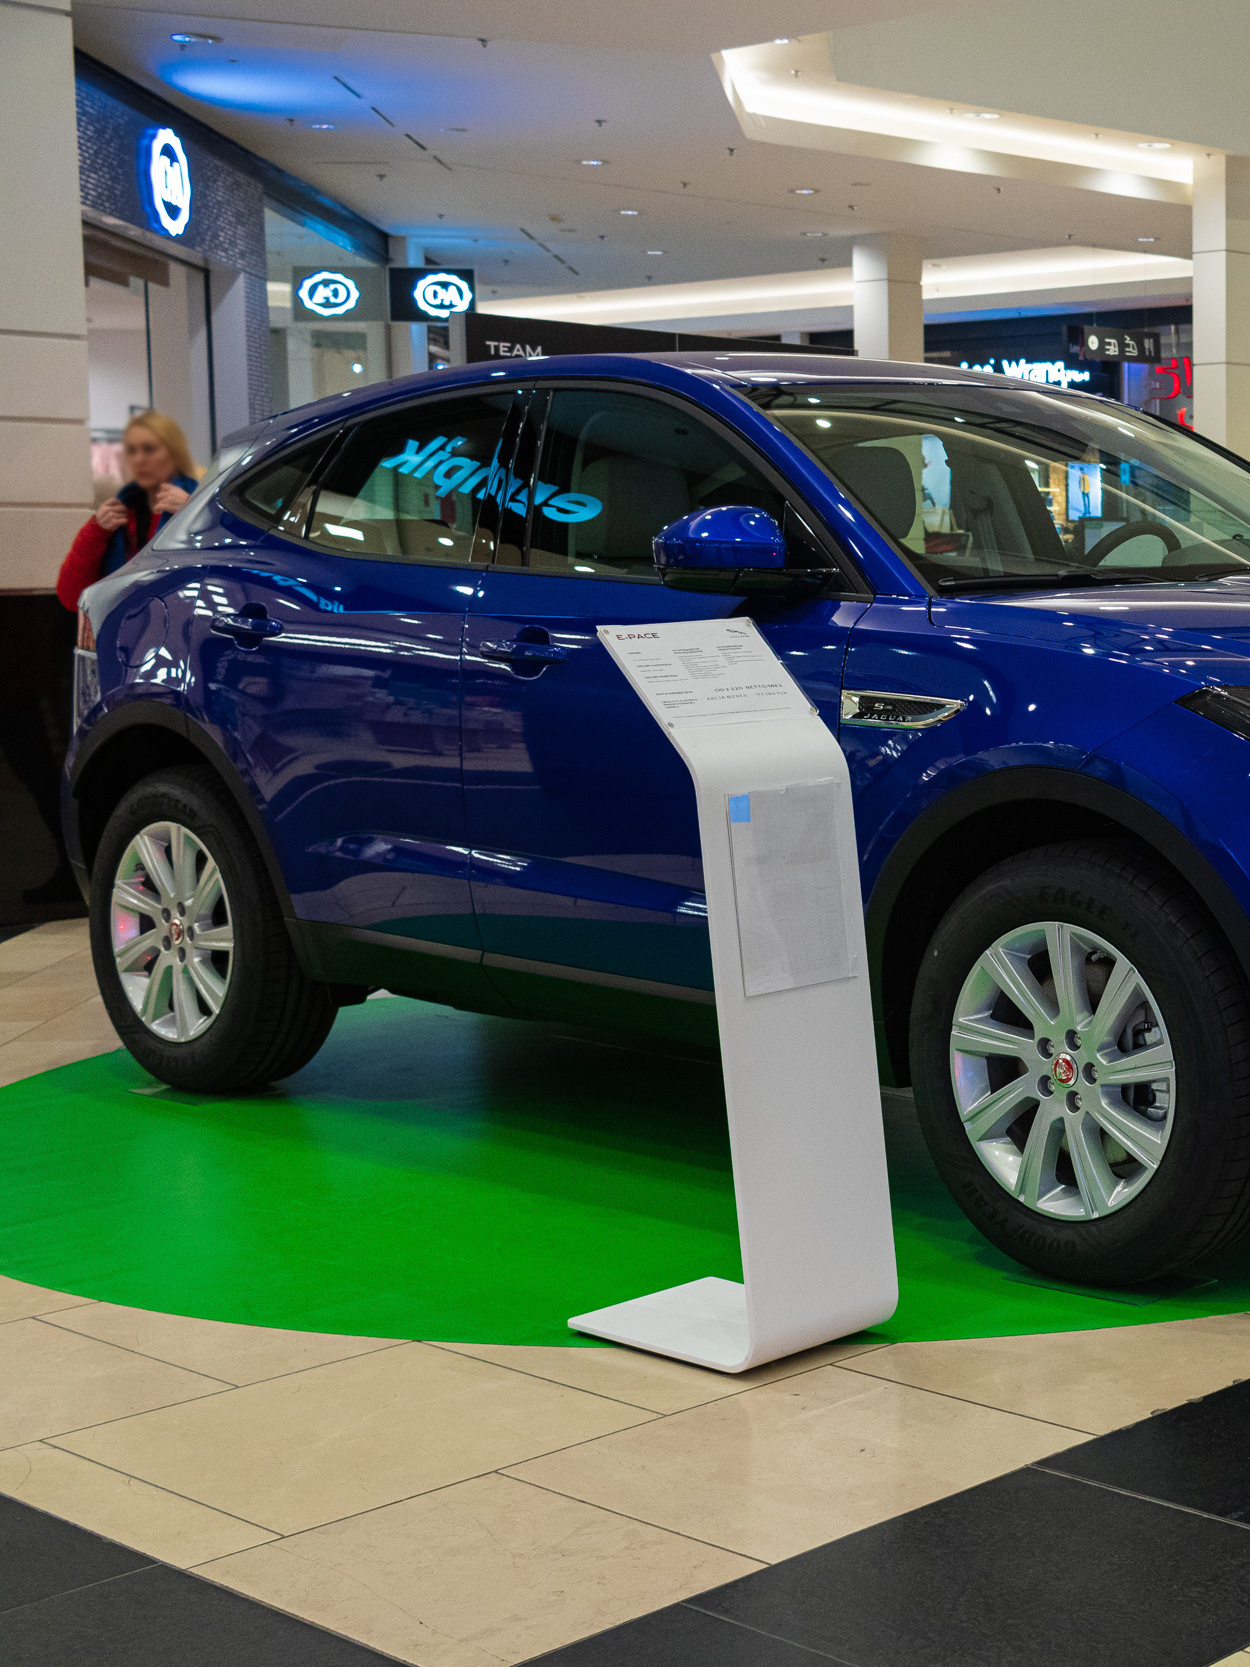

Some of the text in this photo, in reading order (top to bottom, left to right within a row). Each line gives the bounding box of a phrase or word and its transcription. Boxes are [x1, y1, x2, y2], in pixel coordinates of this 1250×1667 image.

[485, 341, 542, 358] TEAM
[615, 632, 660, 641] E-PACE
[863, 713, 912, 722] JAGUAR
